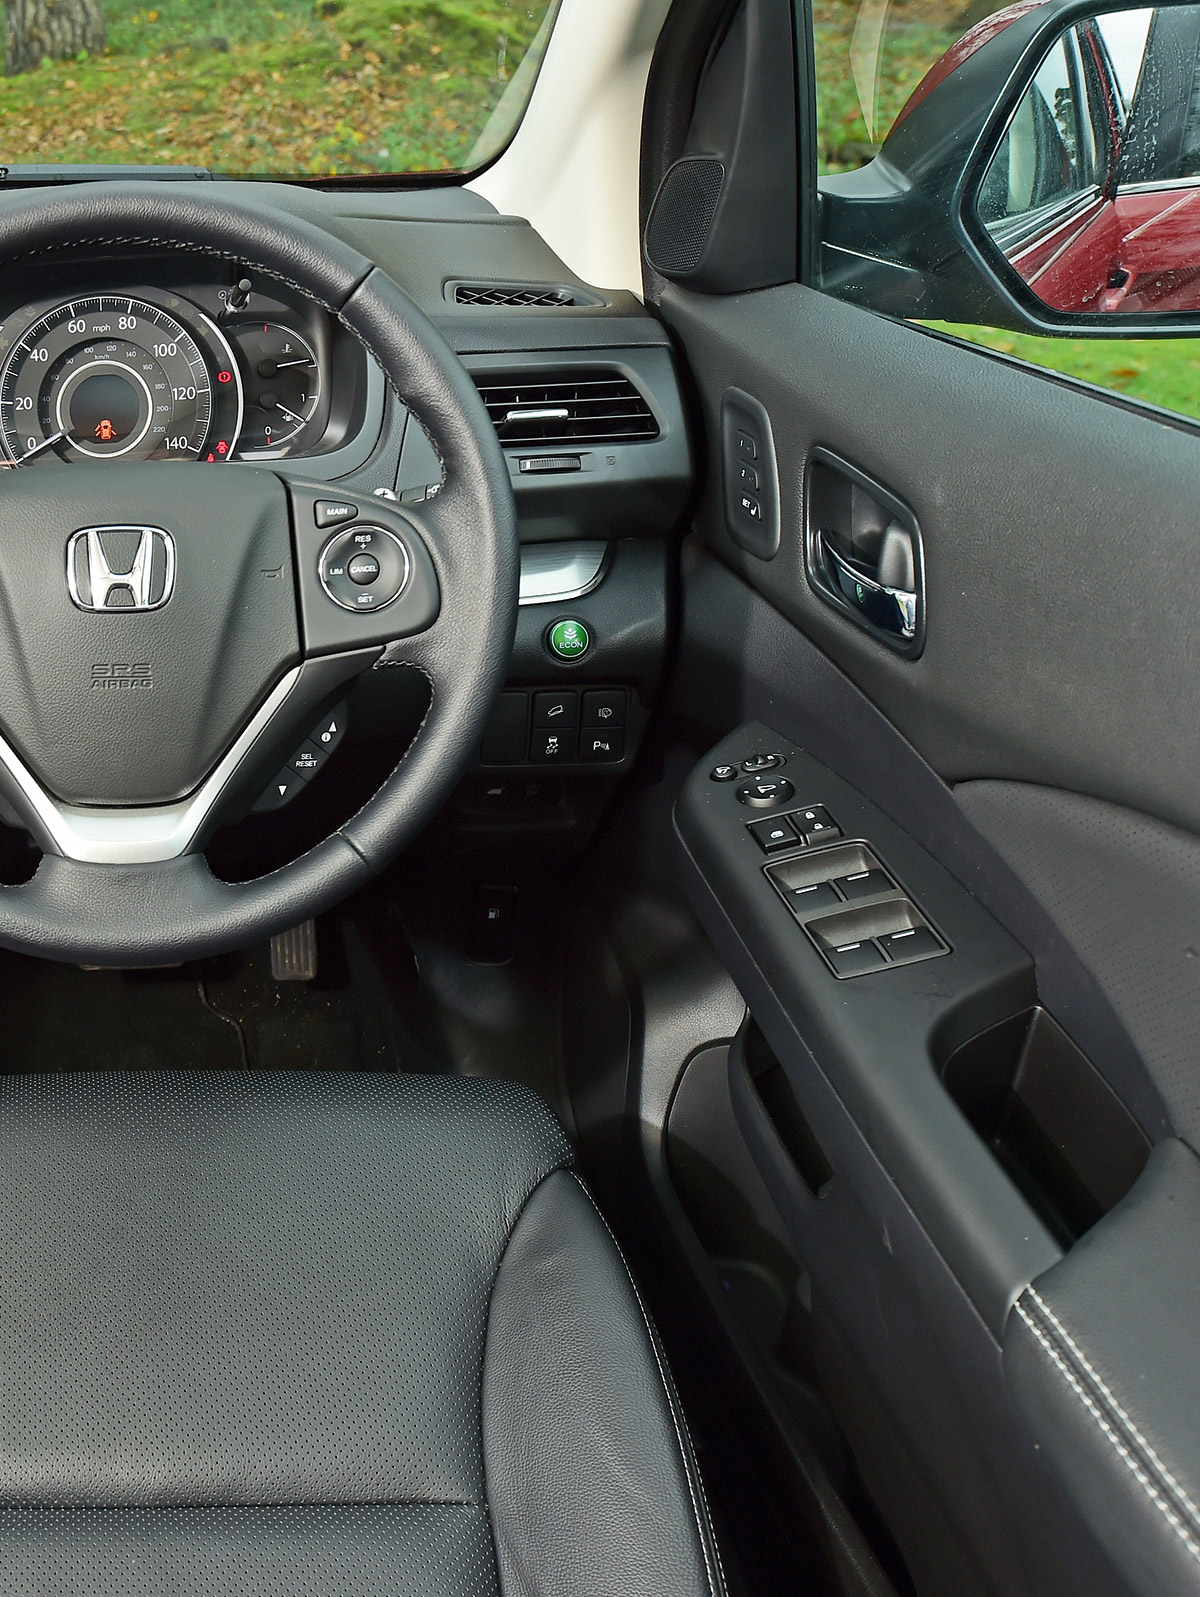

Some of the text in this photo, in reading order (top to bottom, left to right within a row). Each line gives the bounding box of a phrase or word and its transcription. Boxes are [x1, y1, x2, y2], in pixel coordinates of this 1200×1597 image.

[68, 320, 86, 334] 60
[118, 316, 137, 330] 80
[92, 324, 111, 333] mph
[30, 348, 48, 362] 40
[153, 343, 177, 357] 100
[172, 386, 196, 400] 120
[301, 393, 305, 403] 1
[15, 397, 33, 410] 20
[264, 426, 272, 436] 0
[27, 437, 36, 450] 0
[164, 436, 188, 450] 140
[741, 469, 746, 477] 2
[326, 508, 348, 516] MAIN
[355, 535, 371, 543] RES
[350, 565, 377, 574] CANCEL
[357, 595, 374, 603] SET
[560, 641, 583, 649] ECON
[91, 663, 152, 677] SRS
[91, 679, 153, 689] AIRBAG
